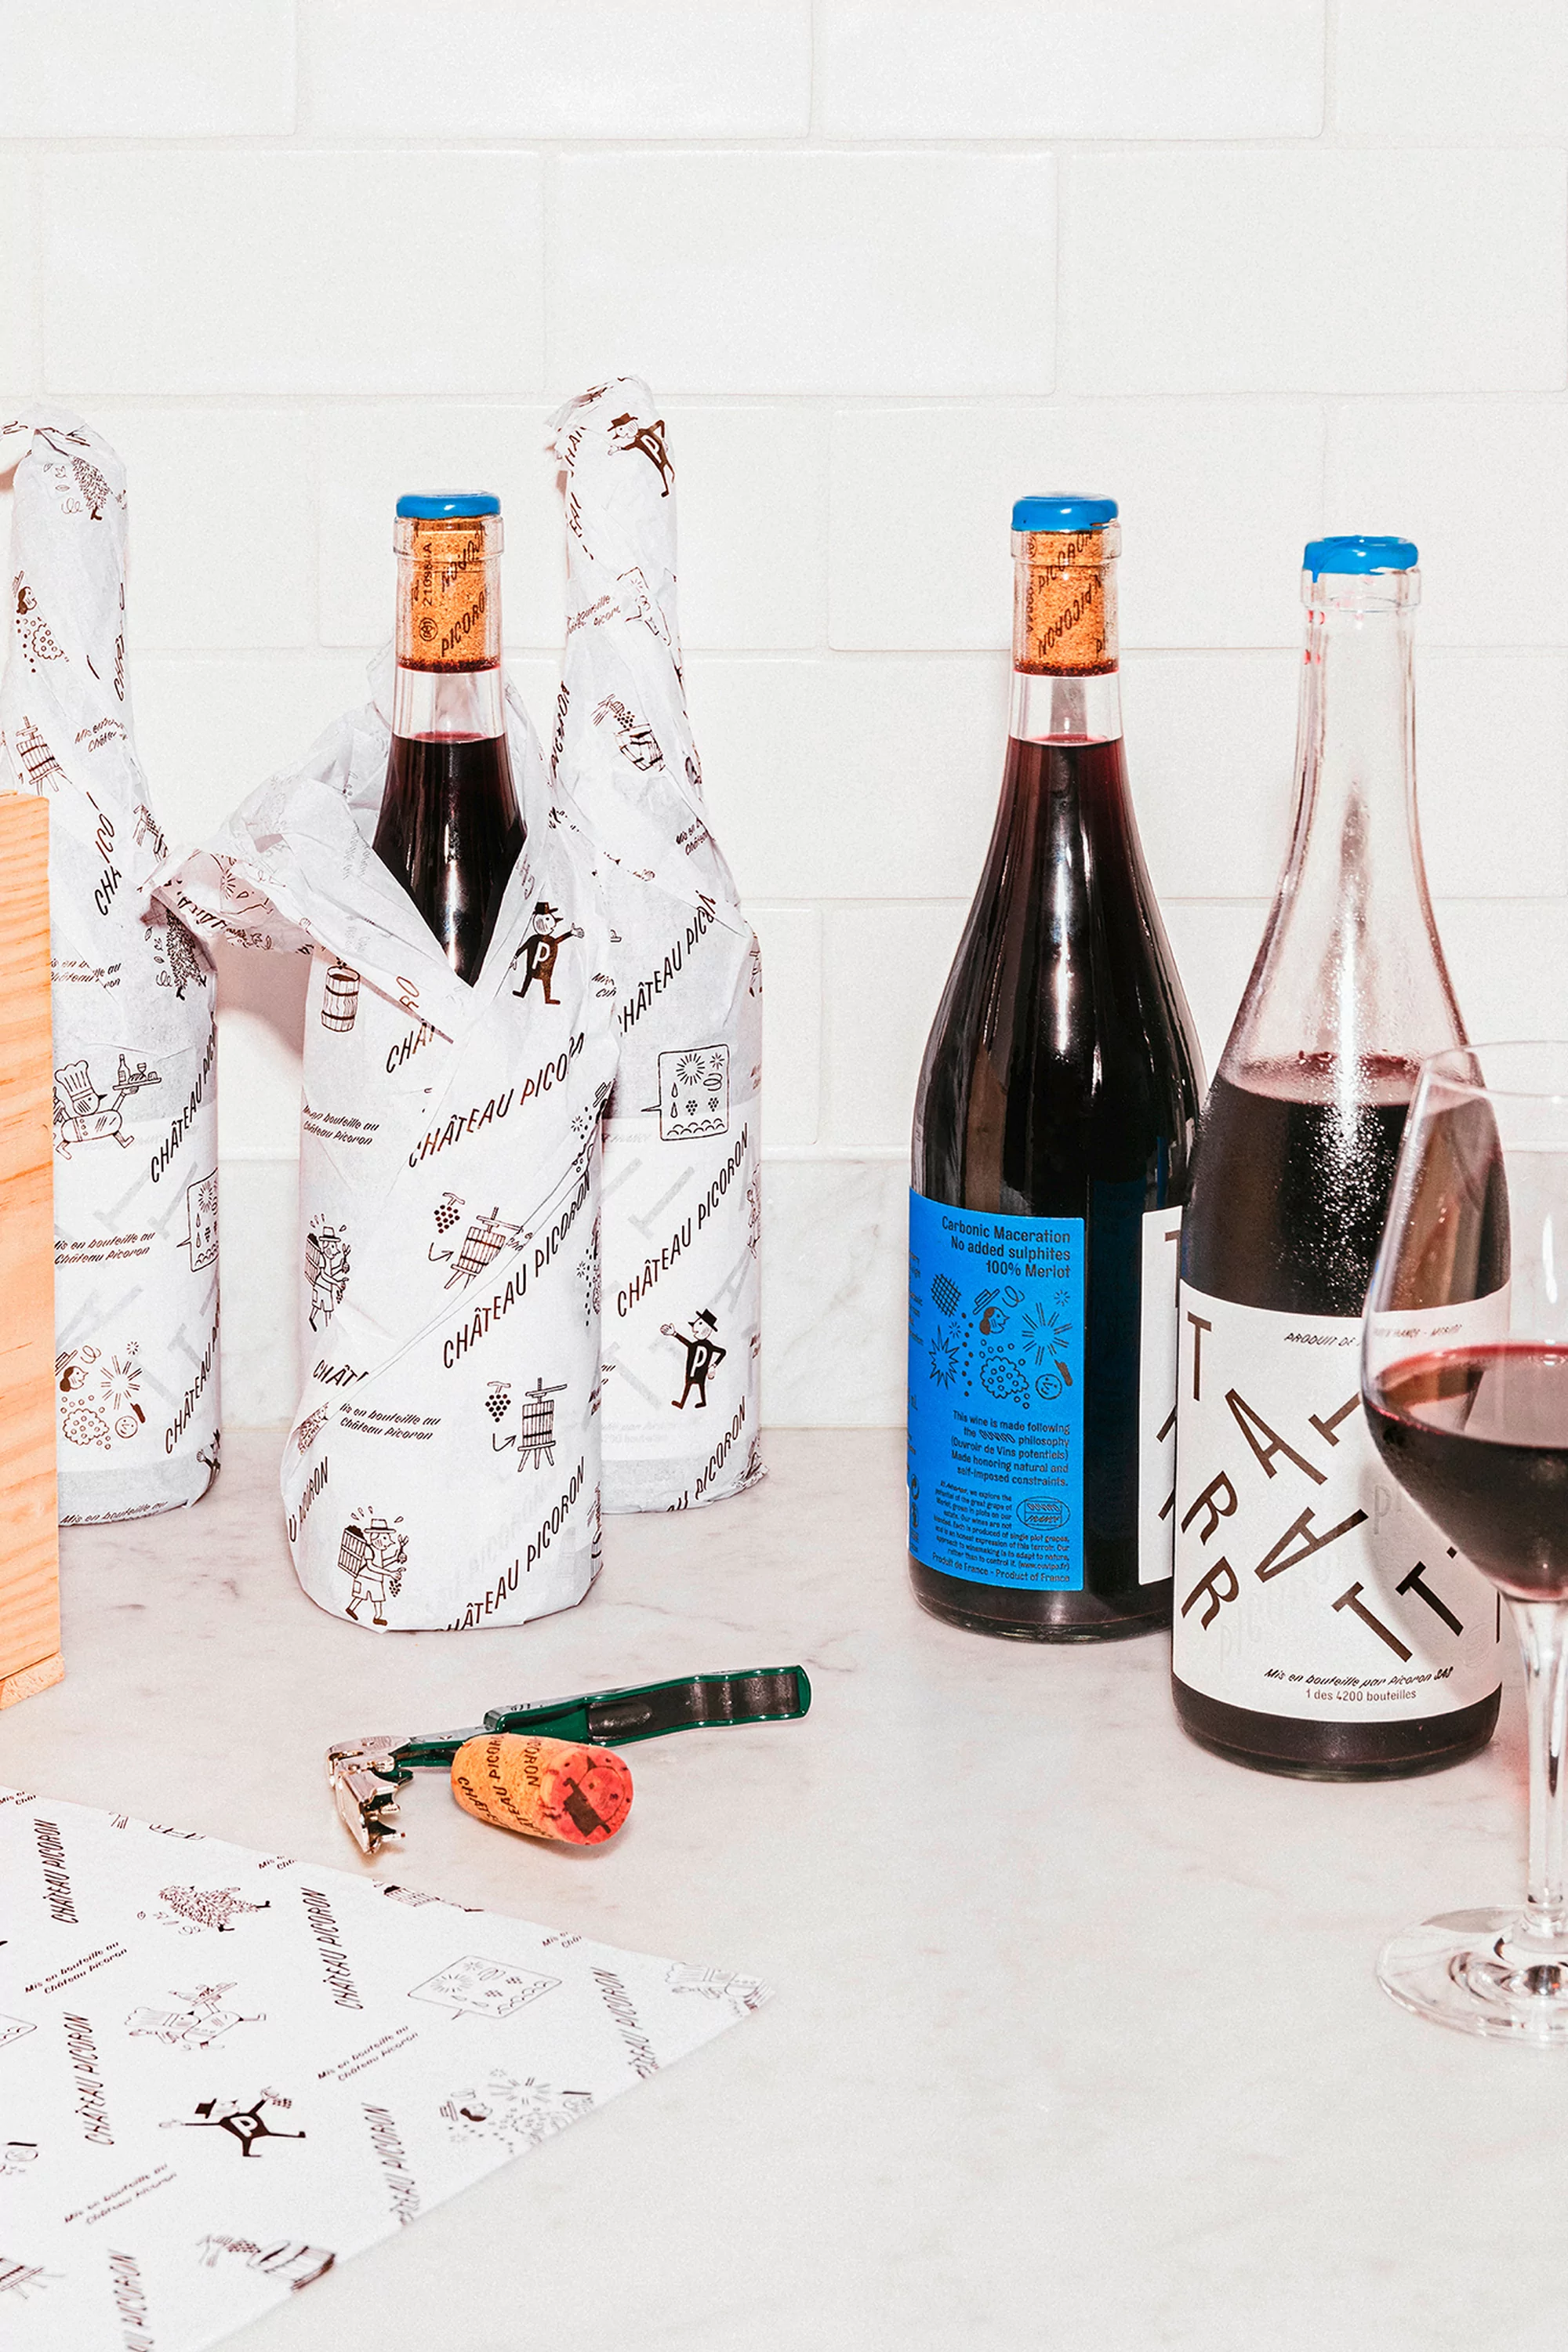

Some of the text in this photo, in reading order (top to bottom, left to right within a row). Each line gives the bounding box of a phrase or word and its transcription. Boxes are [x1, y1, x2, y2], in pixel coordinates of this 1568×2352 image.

[617, 941, 683, 1037] HÂTEAU
[151, 1073, 202, 1183] CHÂTEAU
[323, 1112, 379, 1131] bouteille au
[617, 1122, 749, 1317] CHÂTEAU PICORON
[942, 1215, 1070, 1243] Carbonic Maceration
[71, 1232, 156, 1250] en bouteille au
[951, 1236, 1070, 1262] No added sulphites
[54, 1253, 104, 1265] Château
[444, 1264, 526, 1369] CHÂTEAU
[535, 1172, 591, 1277] PICORON
[986, 1259, 1070, 1278] 100% Merlot
[1283, 1332, 1335, 1346] PRODUIT
[165, 1342, 212, 1454] CHÂTEAU
[340, 1417, 383, 1436] Château
[368, 1410, 421, 1425] bouteille
[422, 1417, 441, 1426] au
[953, 1410, 1070, 1435] This wine is made following
[951, 1436, 1069, 1461] (Ouvroir de Vins potentiels)
[964, 1427, 976, 1438] the
[1018, 1435, 1069, 1448] philosophy
[951, 1450, 1069, 1473] Made honoring natural and
[957, 1466, 1069, 1486] self-imposed constraints.
[528, 1456, 585, 1572] PICORON
[964, 1563, 989, 1576] France
[996, 1569, 1028, 1581] Product
[1030, 1573, 1039, 1581] of
[1041, 1573, 1070, 1582] France
[1265, 1668, 1286, 1681] Mis
[1288, 1674, 1304, 1682] en
[1305, 1673, 1360, 1686] bouteille
[1360, 1676, 1386, 1690] par
[1389, 1671, 1432, 1686] Picoron
[1305, 1688, 1417, 1702] 1 des 4200 bouteilles
[34, 1818, 79, 1925] CHÂTEAU PICORON
[300, 1886, 364, 2010] CHÂTEAU PICORON
[62, 2011, 114, 2145] CHÂTEAU PICORON
